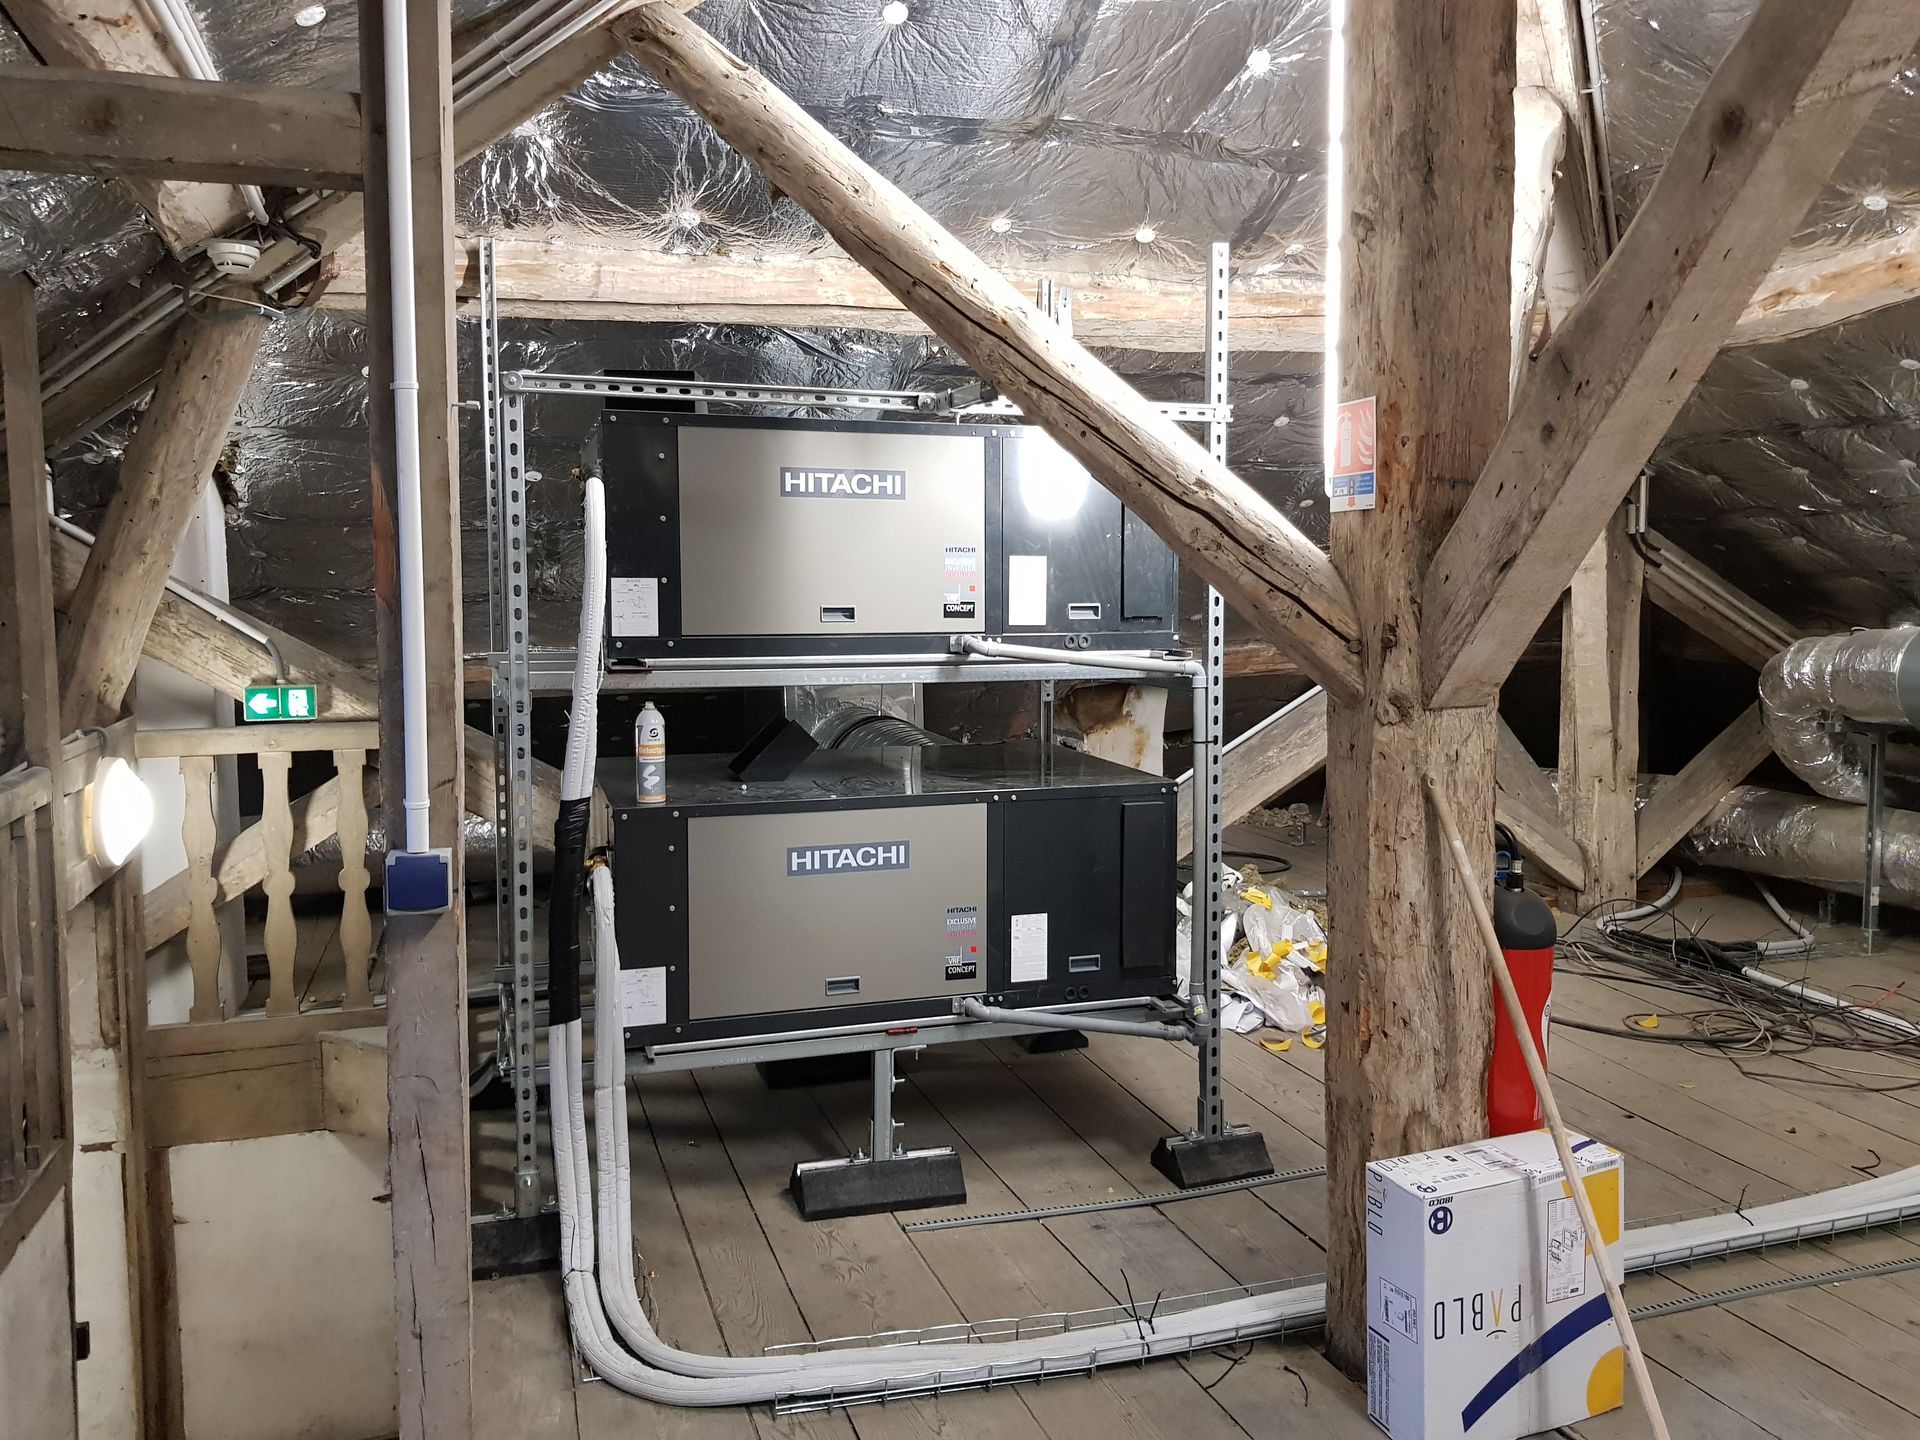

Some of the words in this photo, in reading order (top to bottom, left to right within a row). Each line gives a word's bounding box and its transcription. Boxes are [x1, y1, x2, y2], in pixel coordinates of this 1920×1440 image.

[784, 471, 902, 495] HITACHI
[946, 604, 975, 612] CONCEPT
[791, 845, 905, 871] HITACHI
[946, 906, 977, 914] HITACHI
[946, 917, 977, 926] EXCLUSIVE
[947, 957, 961, 965] VRF
[948, 966, 976, 974] CONCEPT
[1367, 1168, 1385, 1236] PABLO
[1434, 1284, 1521, 1340] PABLO
